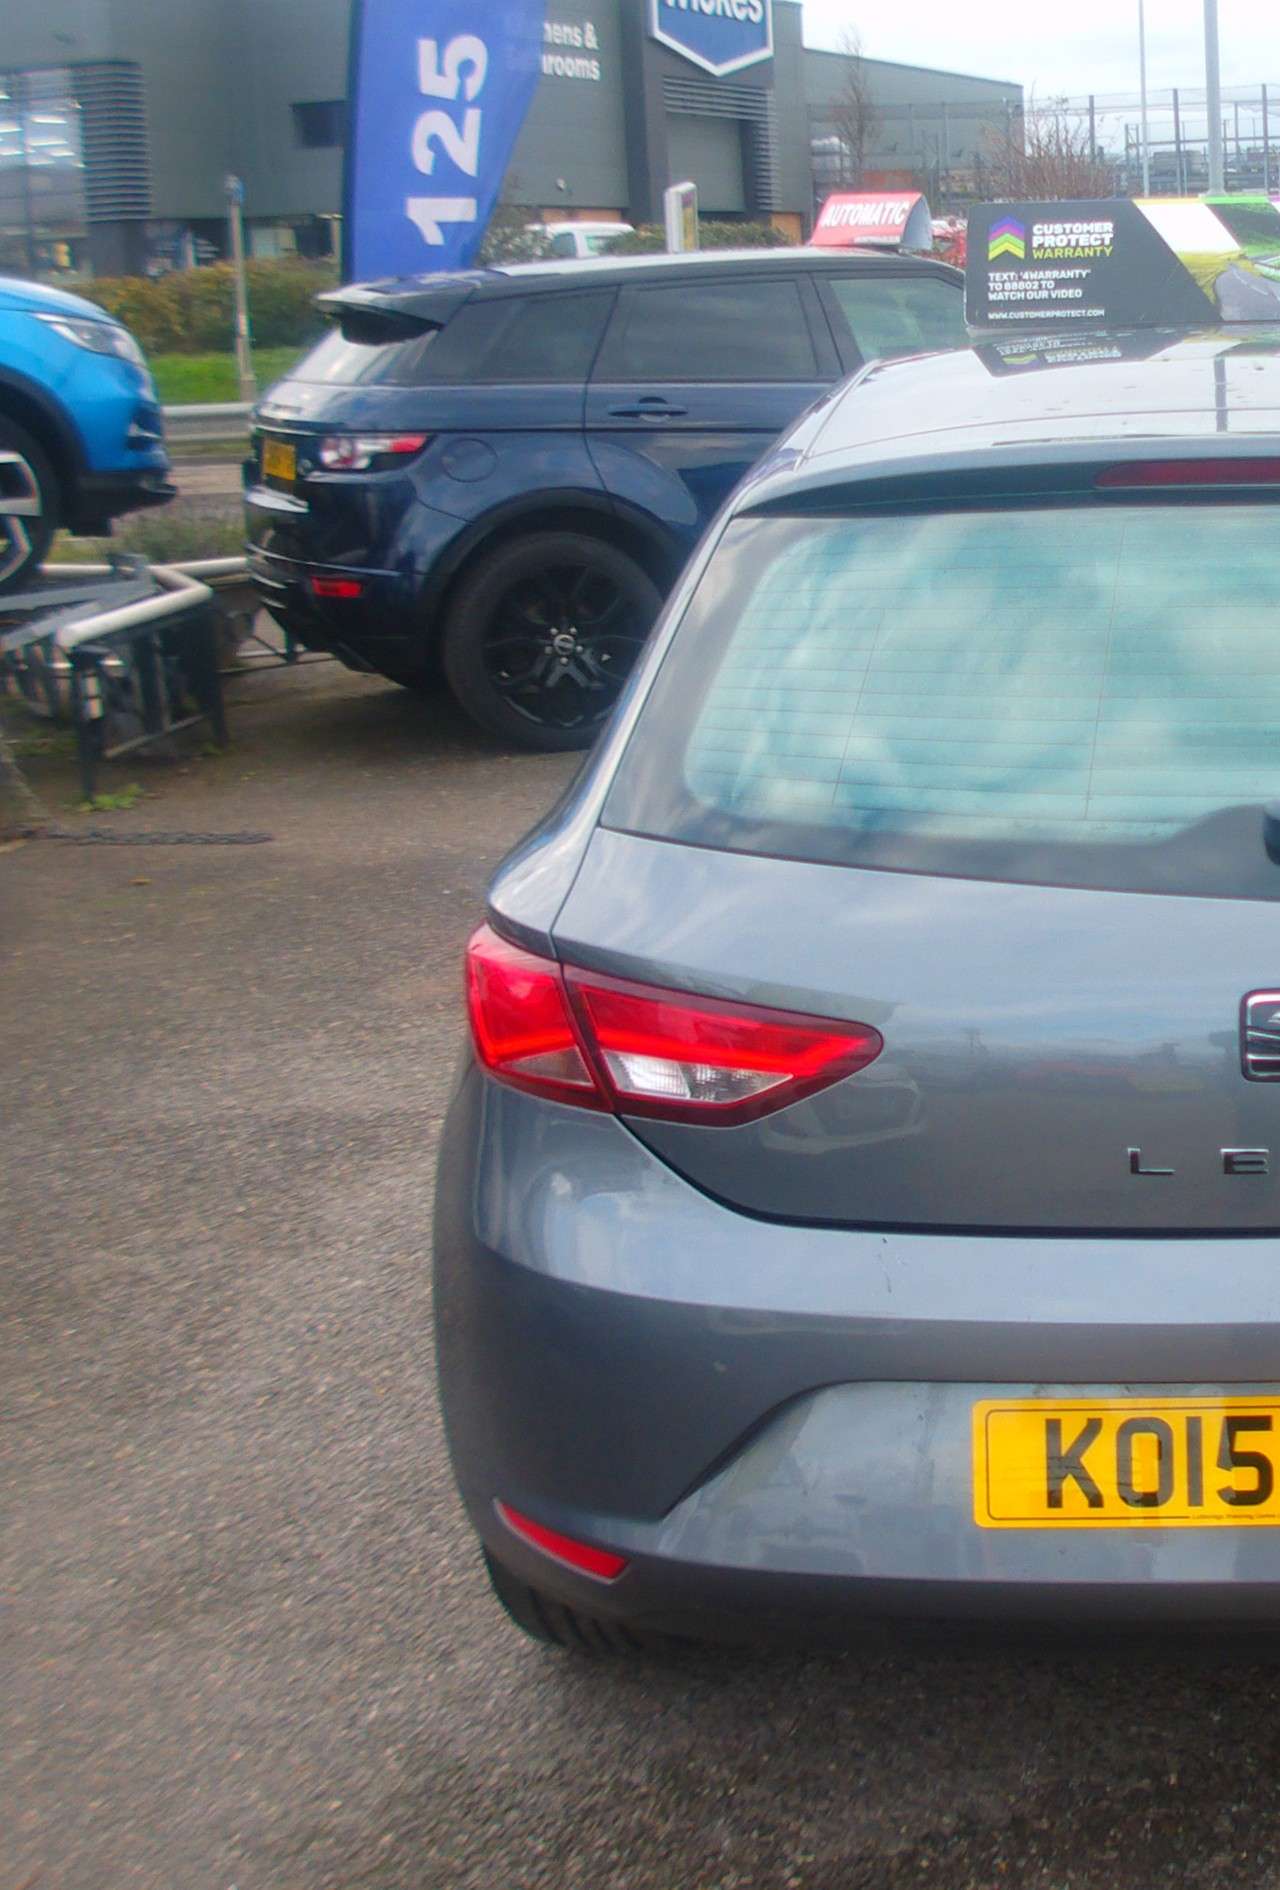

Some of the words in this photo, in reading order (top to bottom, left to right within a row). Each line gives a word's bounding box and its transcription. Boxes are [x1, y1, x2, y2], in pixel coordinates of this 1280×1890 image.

[584, 22, 599, 50] &
[406, 34, 488, 246] 125
[821, 201, 911, 228] AUTOMATIC
[1032, 222, 1114, 235] CUSTOMER
[1032, 234, 1114, 248] PROTECT
[1032, 247, 1113, 259] WARRANTY
[988, 282, 1003, 292] TO
[1040, 280, 1055, 290] TO
[988, 291, 1025, 301] WATCH
[1026, 290, 1050, 300] OUR
[1050, 288, 1083, 299] VIDEO
[1045, 1415, 1274, 1509] KO15
